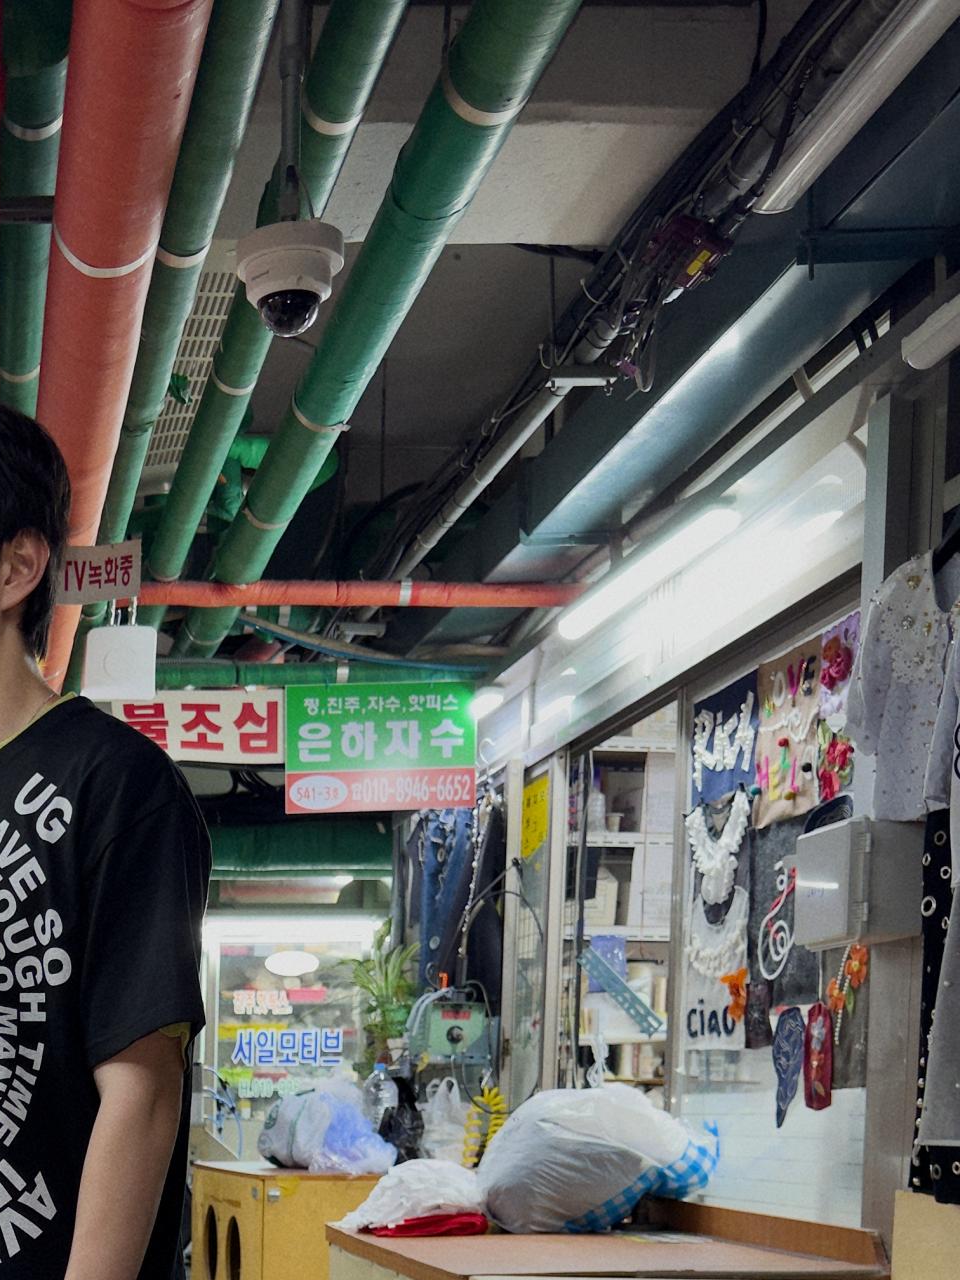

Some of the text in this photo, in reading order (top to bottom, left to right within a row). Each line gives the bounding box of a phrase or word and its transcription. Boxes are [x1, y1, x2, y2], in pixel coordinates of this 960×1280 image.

[122, 700, 279, 754] 불조심
[297, 718, 465, 763] 은하자수
[14, 772, 74, 845] UG
[34, 909, 72, 986] SO
[232, 1027, 343, 1066] 서일모티브
